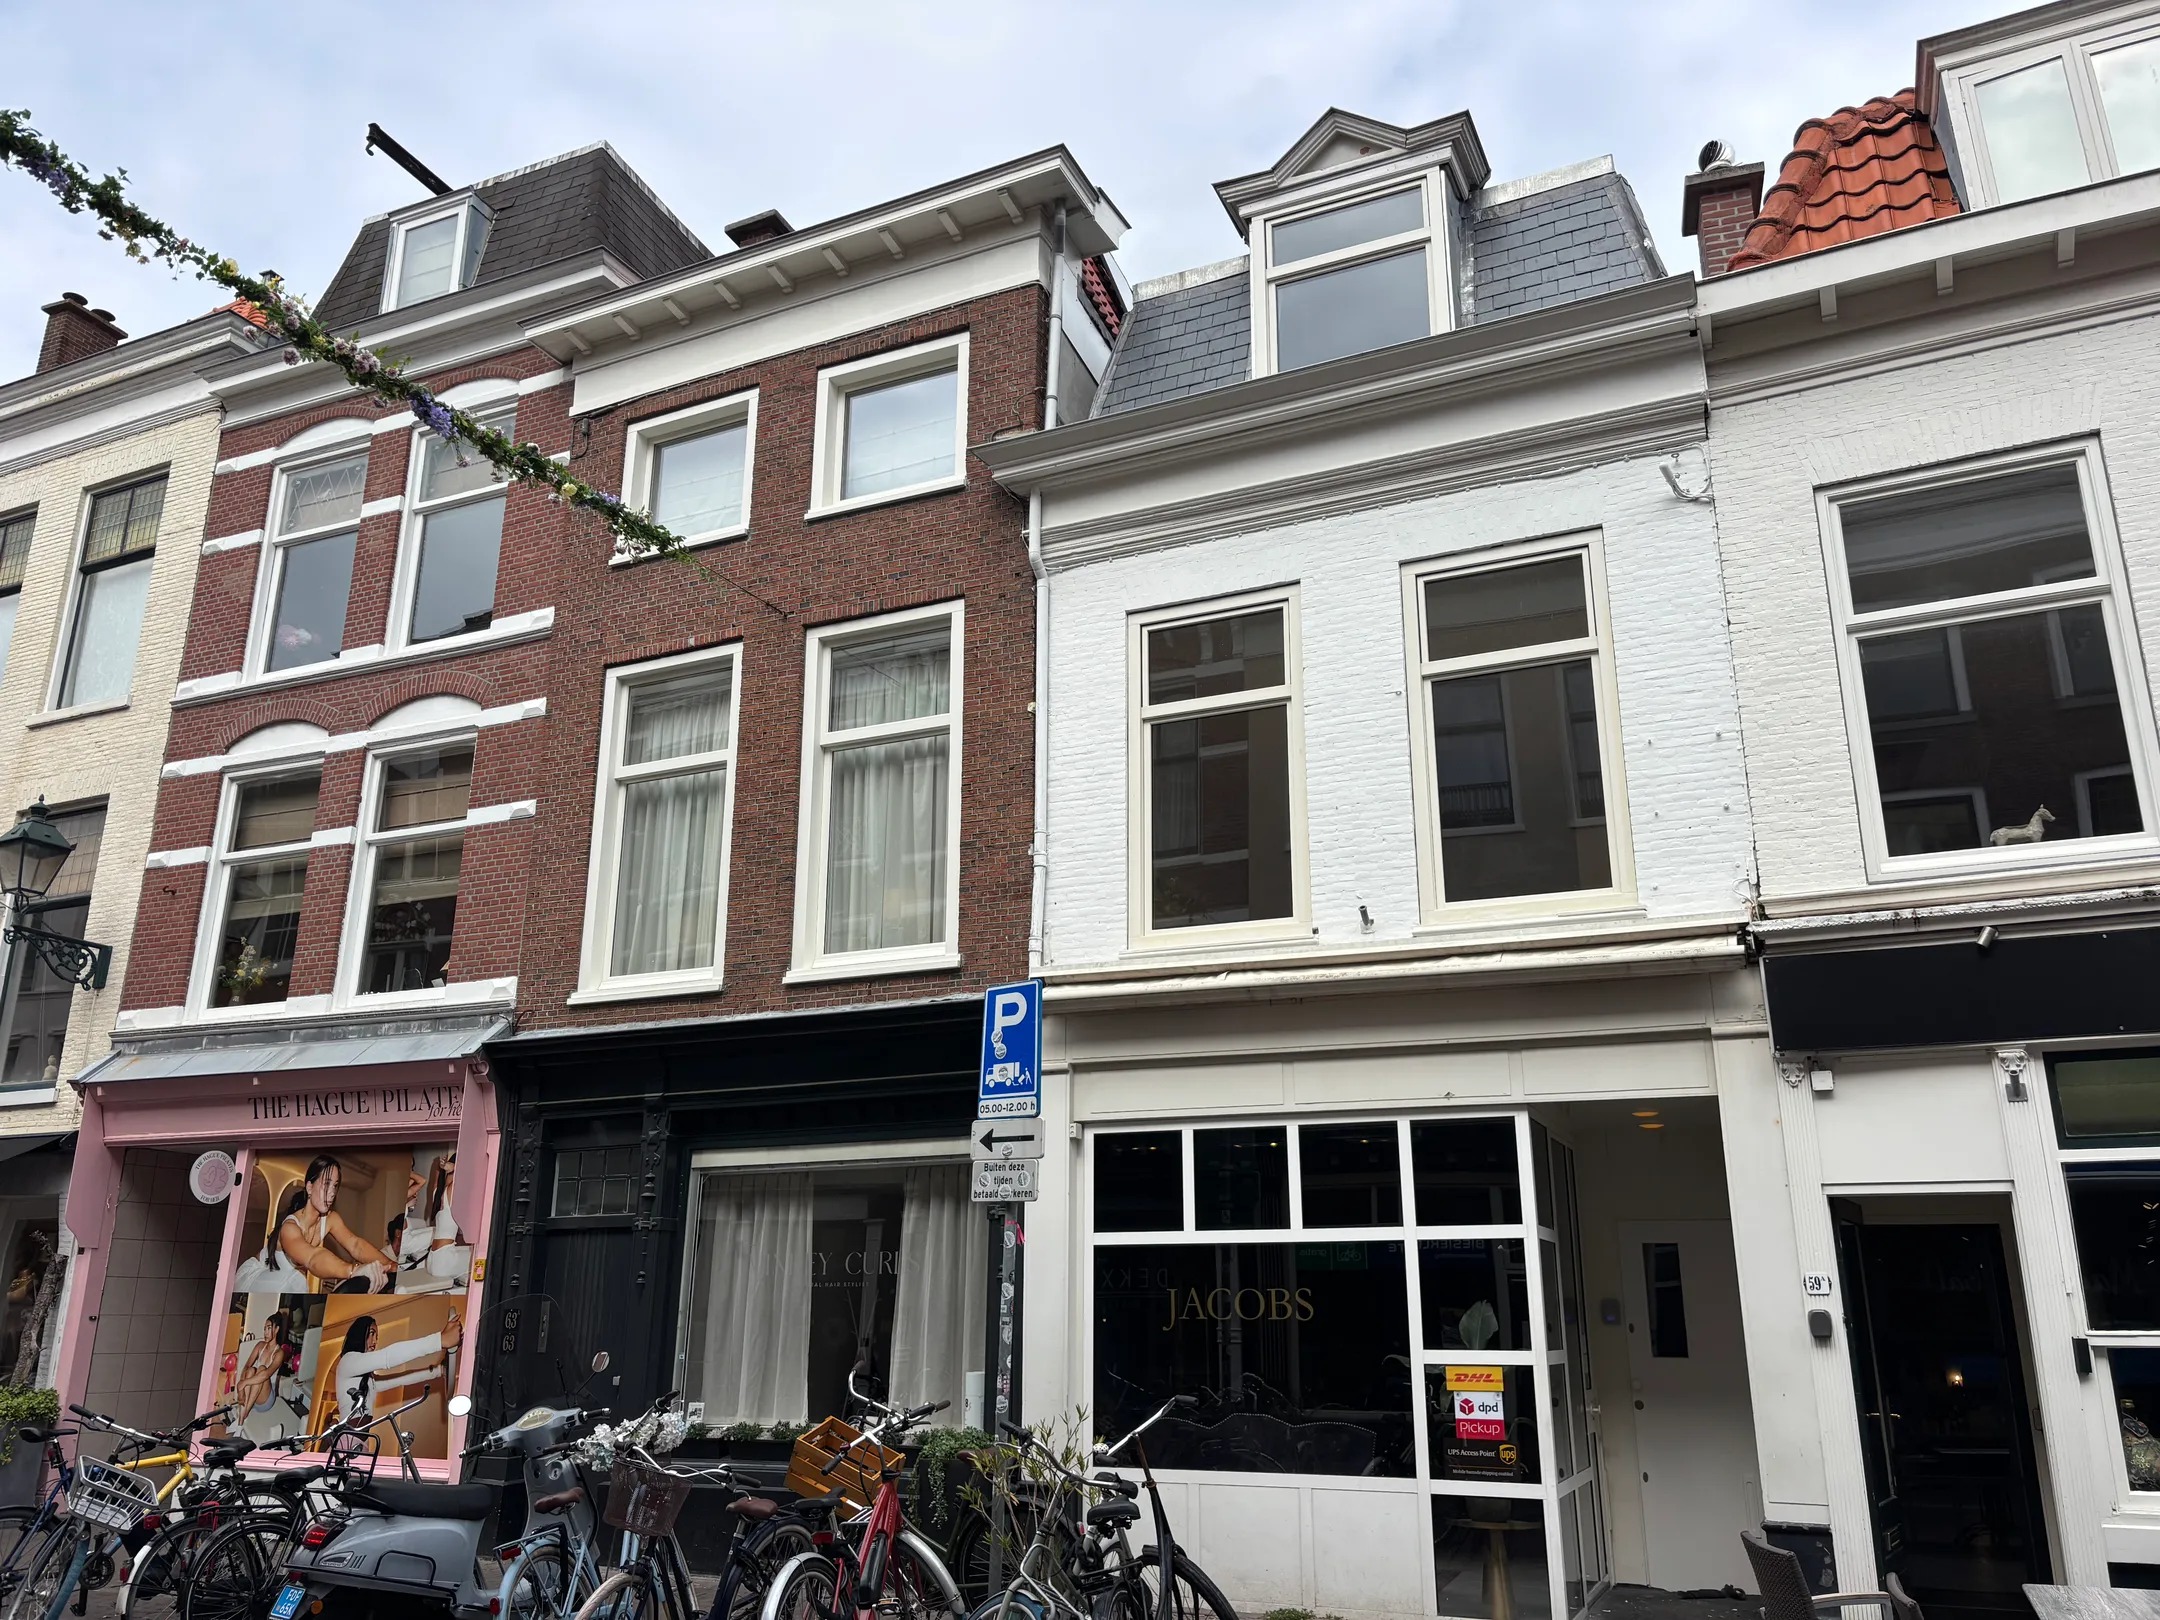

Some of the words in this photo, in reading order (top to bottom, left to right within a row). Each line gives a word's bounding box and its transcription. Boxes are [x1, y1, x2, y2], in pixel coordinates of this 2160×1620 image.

[994, 992, 1028, 1047] P
[249, 1096, 290, 1120] THE
[296, 1090, 370, 1117] HAGUE
[383, 1086, 464, 1113] PILATE
[979, 1101, 1028, 1114] 05.00-12.00
[1030, 1100, 1036, 1111] h
[425, 1101, 447, 1121] for
[448, 1101, 463, 1117] he
[984, 1162, 1007, 1172] Buiten
[1009, 1162, 1025, 1171] deze
[994, 1175, 1013, 1186] tijden
[974, 1189, 999, 1198] betaald
[1162, 1287, 1315, 1332] JACOBS
[502, 1335, 515, 1351] 63
[1454, 1373, 1494, 1382] DHL
[1478, 1402, 1499, 1415] dpd
[1460, 1421, 1500, 1435] Pickup
[1447, 1448, 1460, 1456] UPS
[1460, 1449, 1479, 1457] Access
[1501, 1451, 1515, 1461] ups
